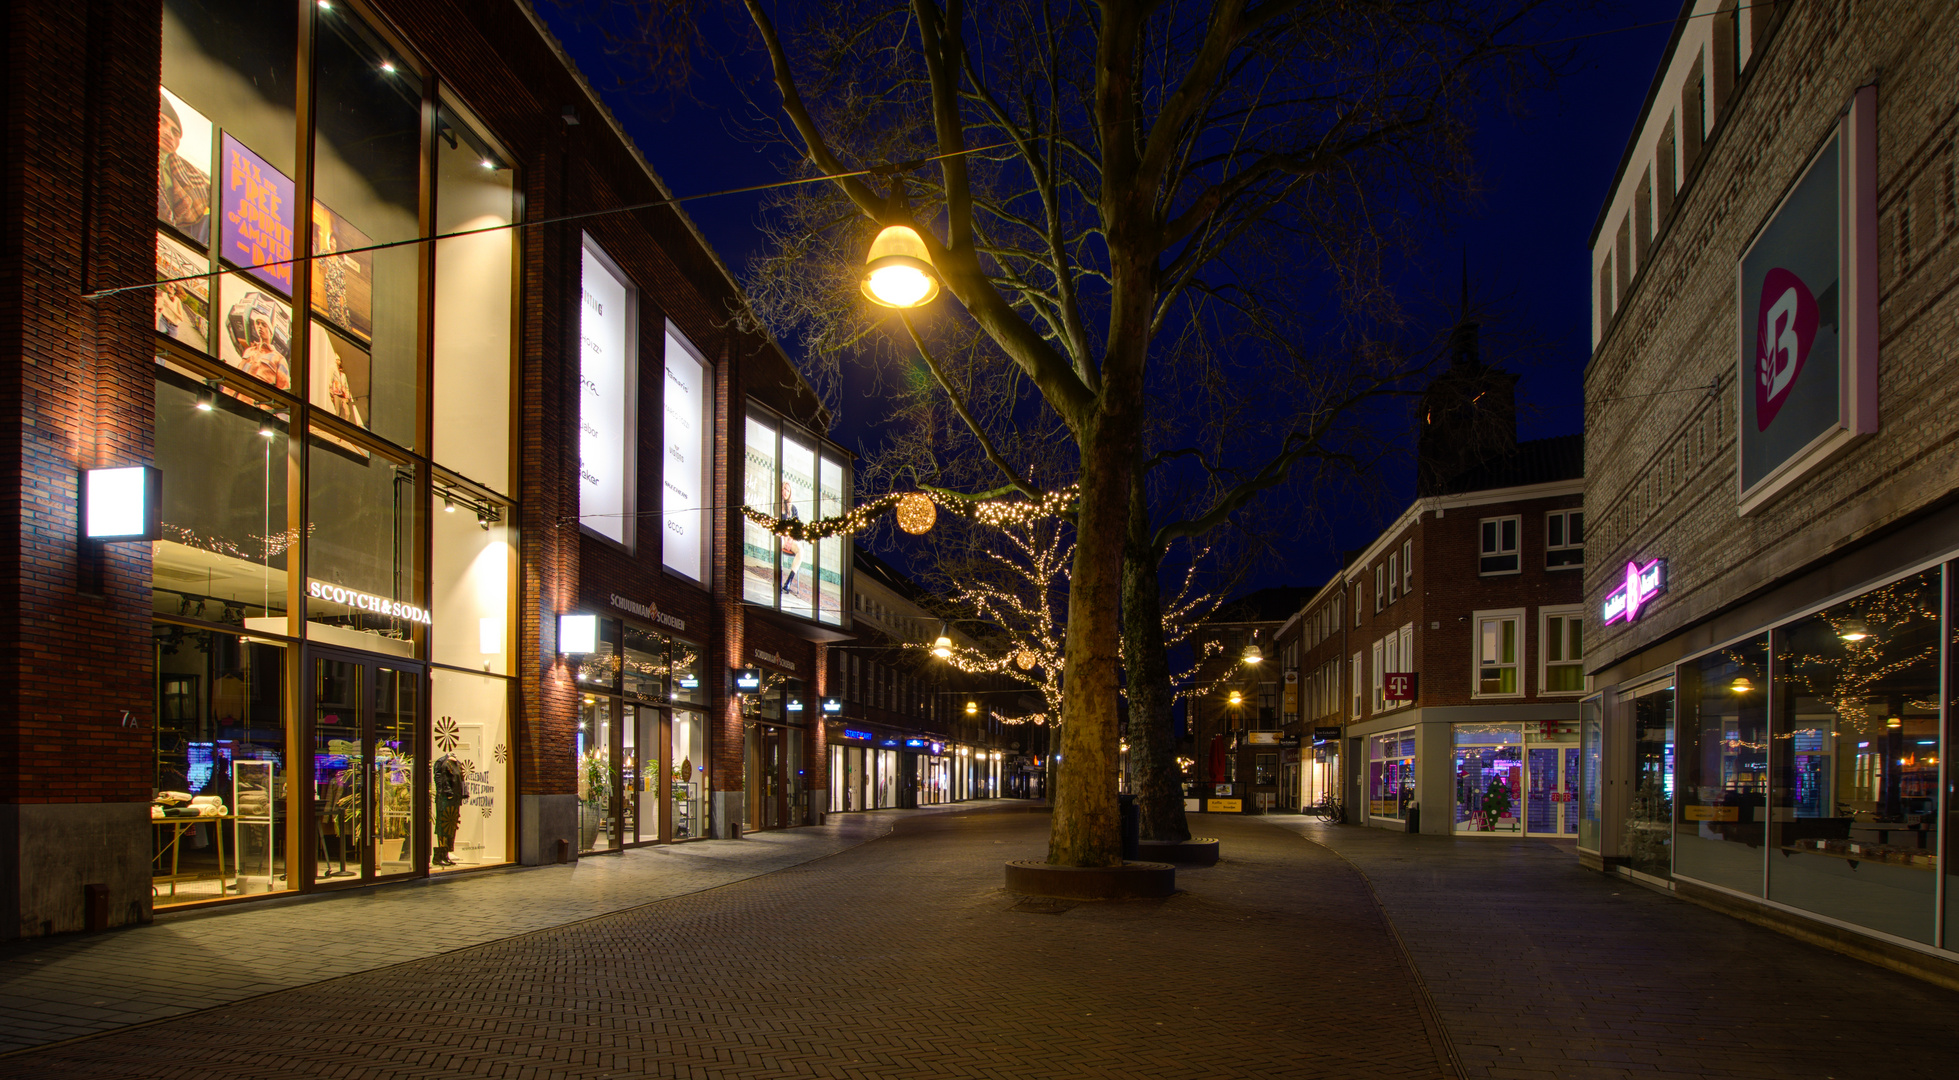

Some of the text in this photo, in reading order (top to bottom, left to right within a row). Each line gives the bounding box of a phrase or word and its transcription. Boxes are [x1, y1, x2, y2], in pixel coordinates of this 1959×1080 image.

[231, 148, 278, 195] XXX THE
[231, 165, 282, 222] FREE
[228, 211, 242, 224] OF
[237, 198, 293, 247] SPIRIT
[252, 242, 291, 286] DAM
[1767, 286, 1798, 402] B
[310, 581, 432, 624] SCOTCH&SODA
[610, 593, 685, 631] SCHUURMAN SCHOENEN
[120, 709, 138, 729] 7A
